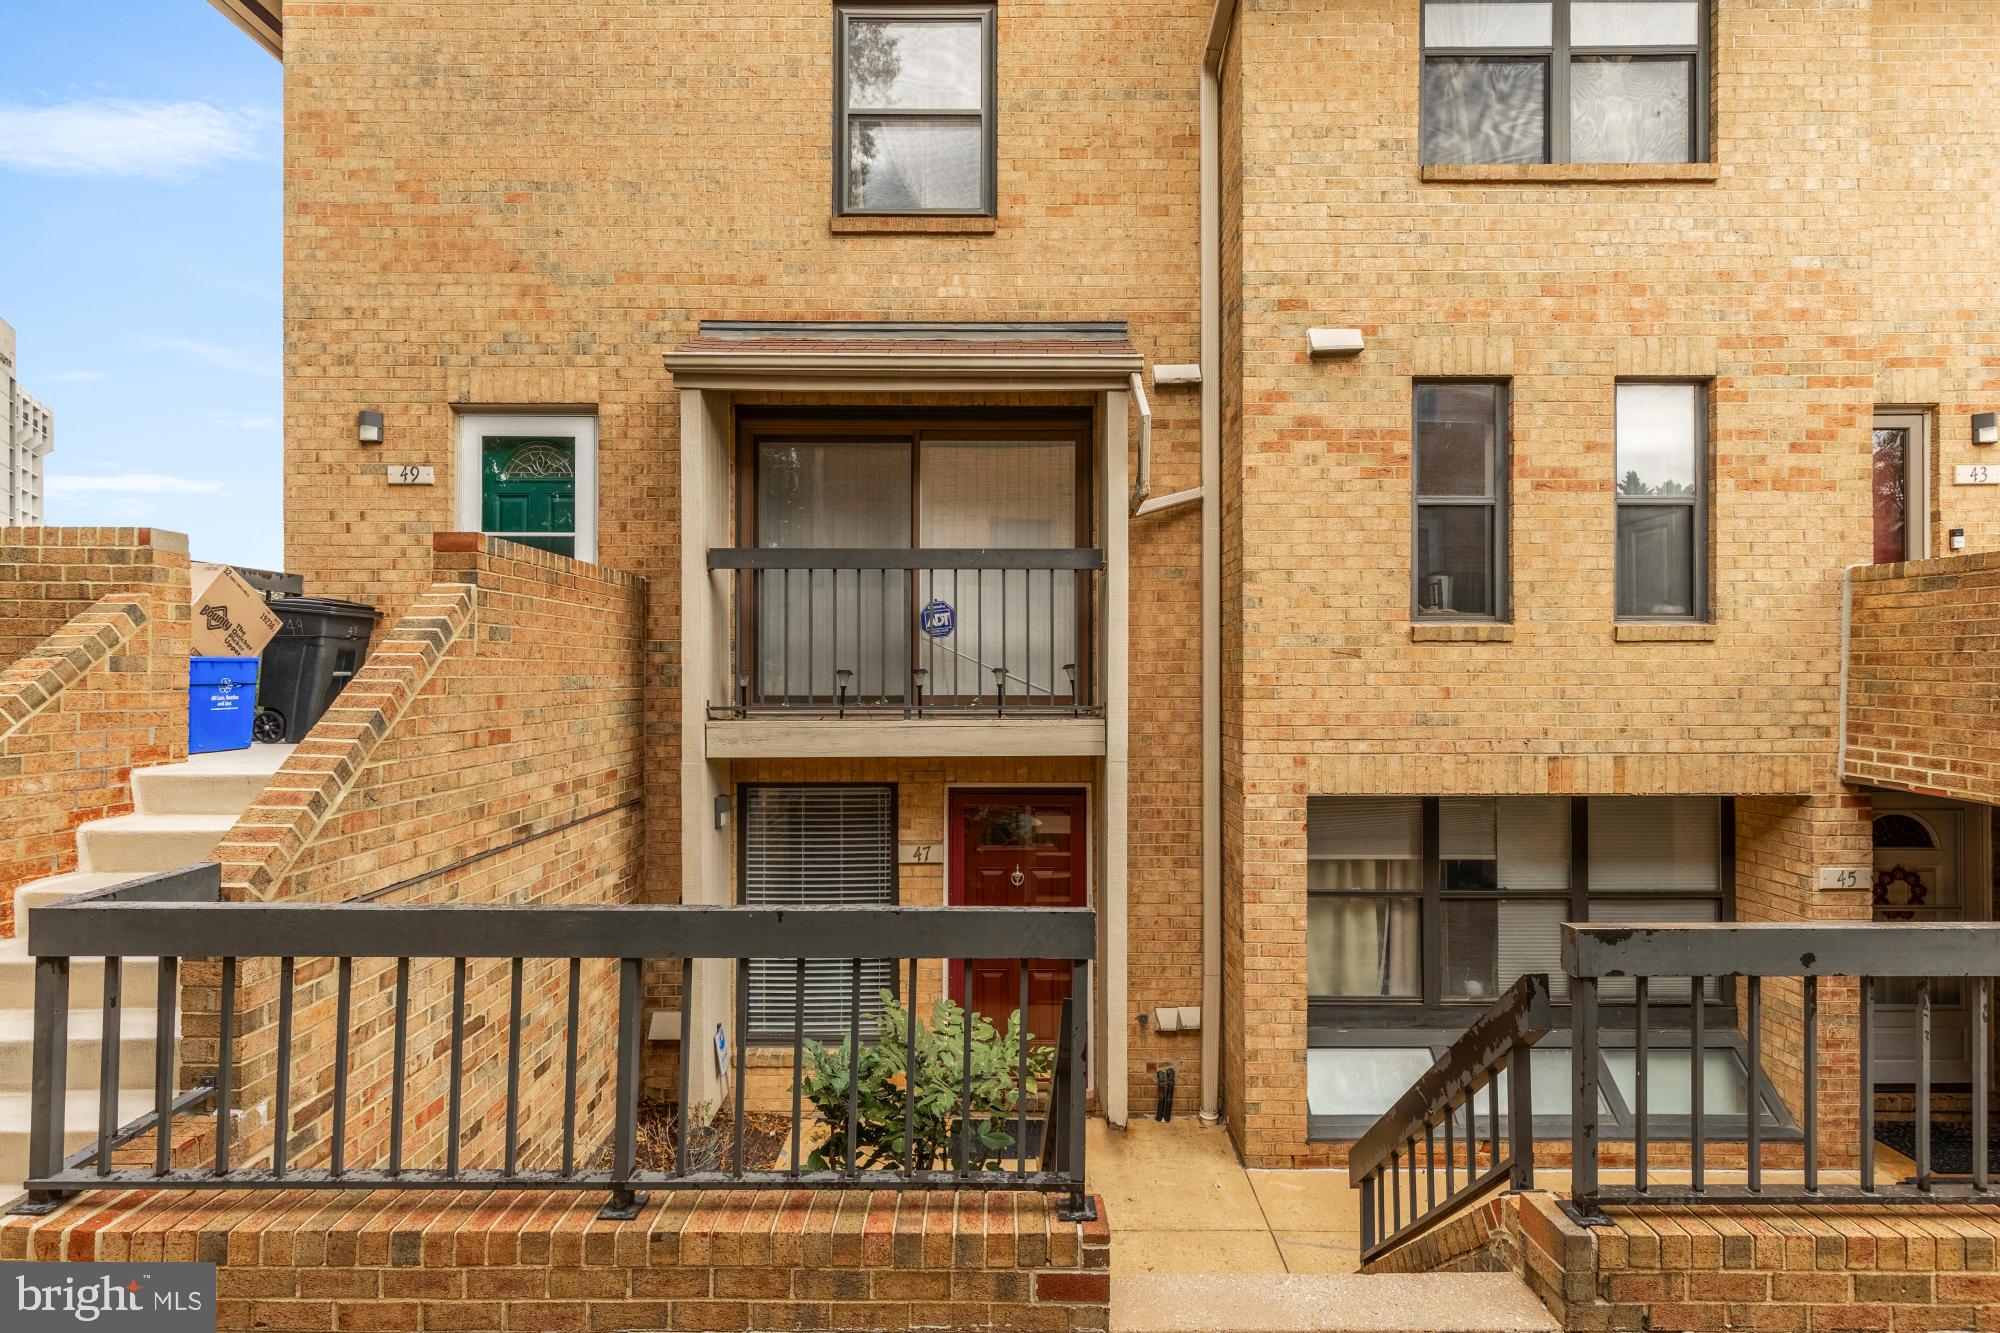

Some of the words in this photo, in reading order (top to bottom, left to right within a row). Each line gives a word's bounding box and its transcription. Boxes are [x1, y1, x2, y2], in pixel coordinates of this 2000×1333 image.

[400, 465, 419, 483] 49
[1970, 466, 1988, 483] 43
[223, 567, 232, 576] 12
[199, 604, 232, 631] Bounty
[927, 612, 950, 627] ADT
[236, 623, 247, 635] The
[224, 637, 241, 656] Upper
[232, 628, 253, 650] Quicker
[913, 845, 931, 863] 47
[1837, 870, 1857, 888] 45
